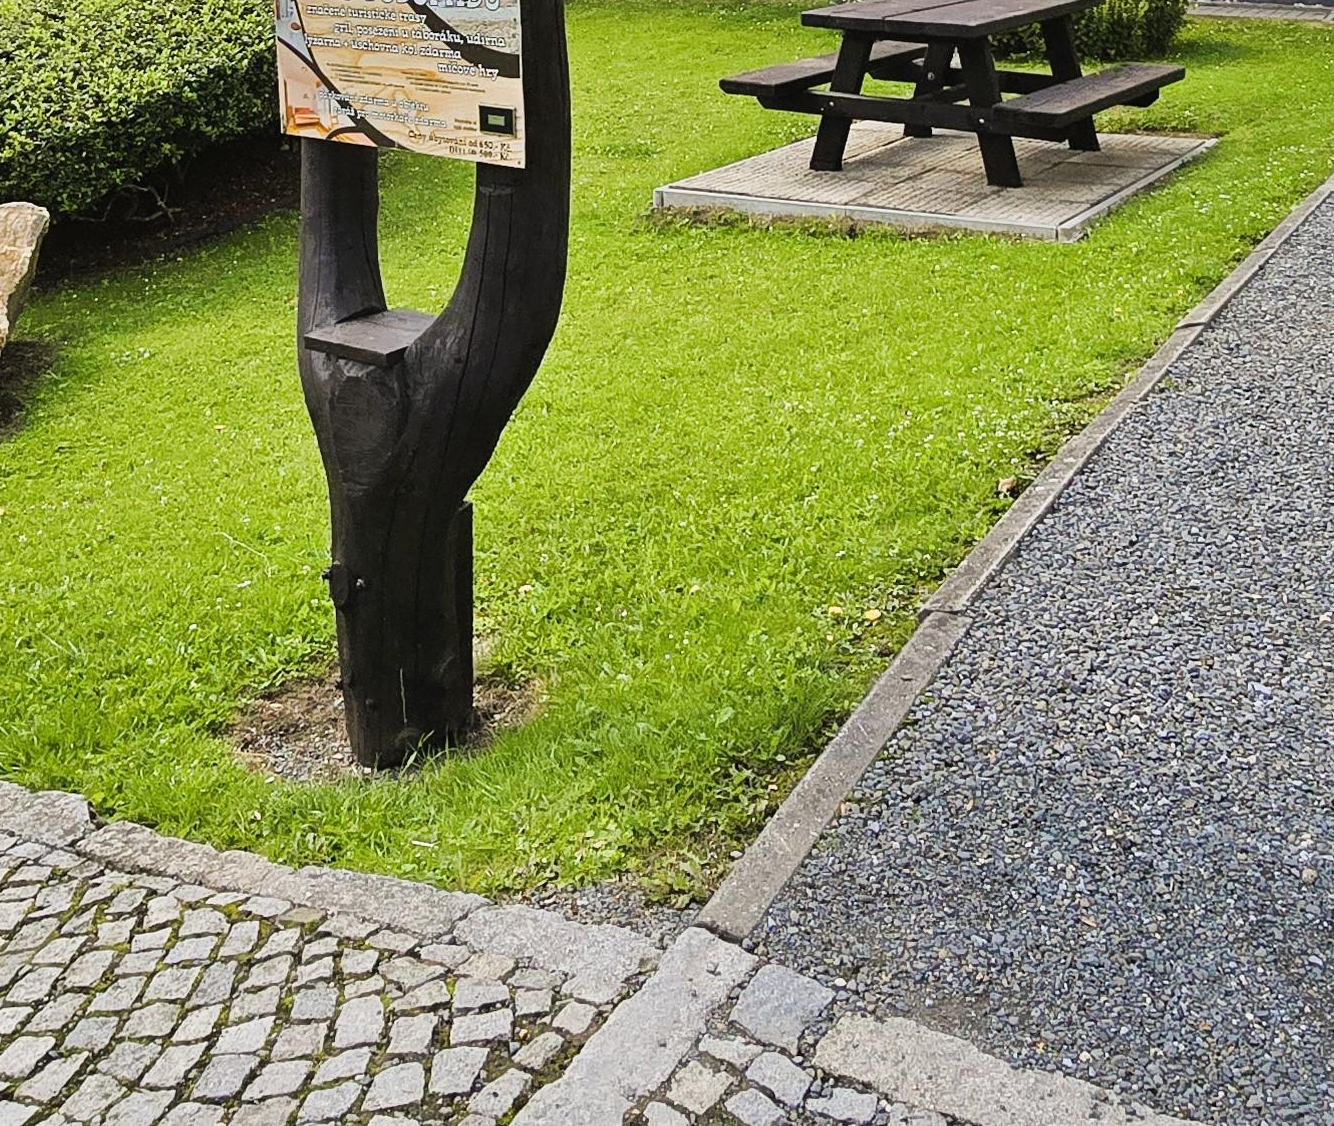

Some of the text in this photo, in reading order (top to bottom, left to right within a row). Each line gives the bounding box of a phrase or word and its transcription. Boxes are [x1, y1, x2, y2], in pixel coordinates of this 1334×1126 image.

[398, 11, 427, 24] trasy
[419, 44, 462, 59] zdarma
[478, 64, 499, 80] hry
